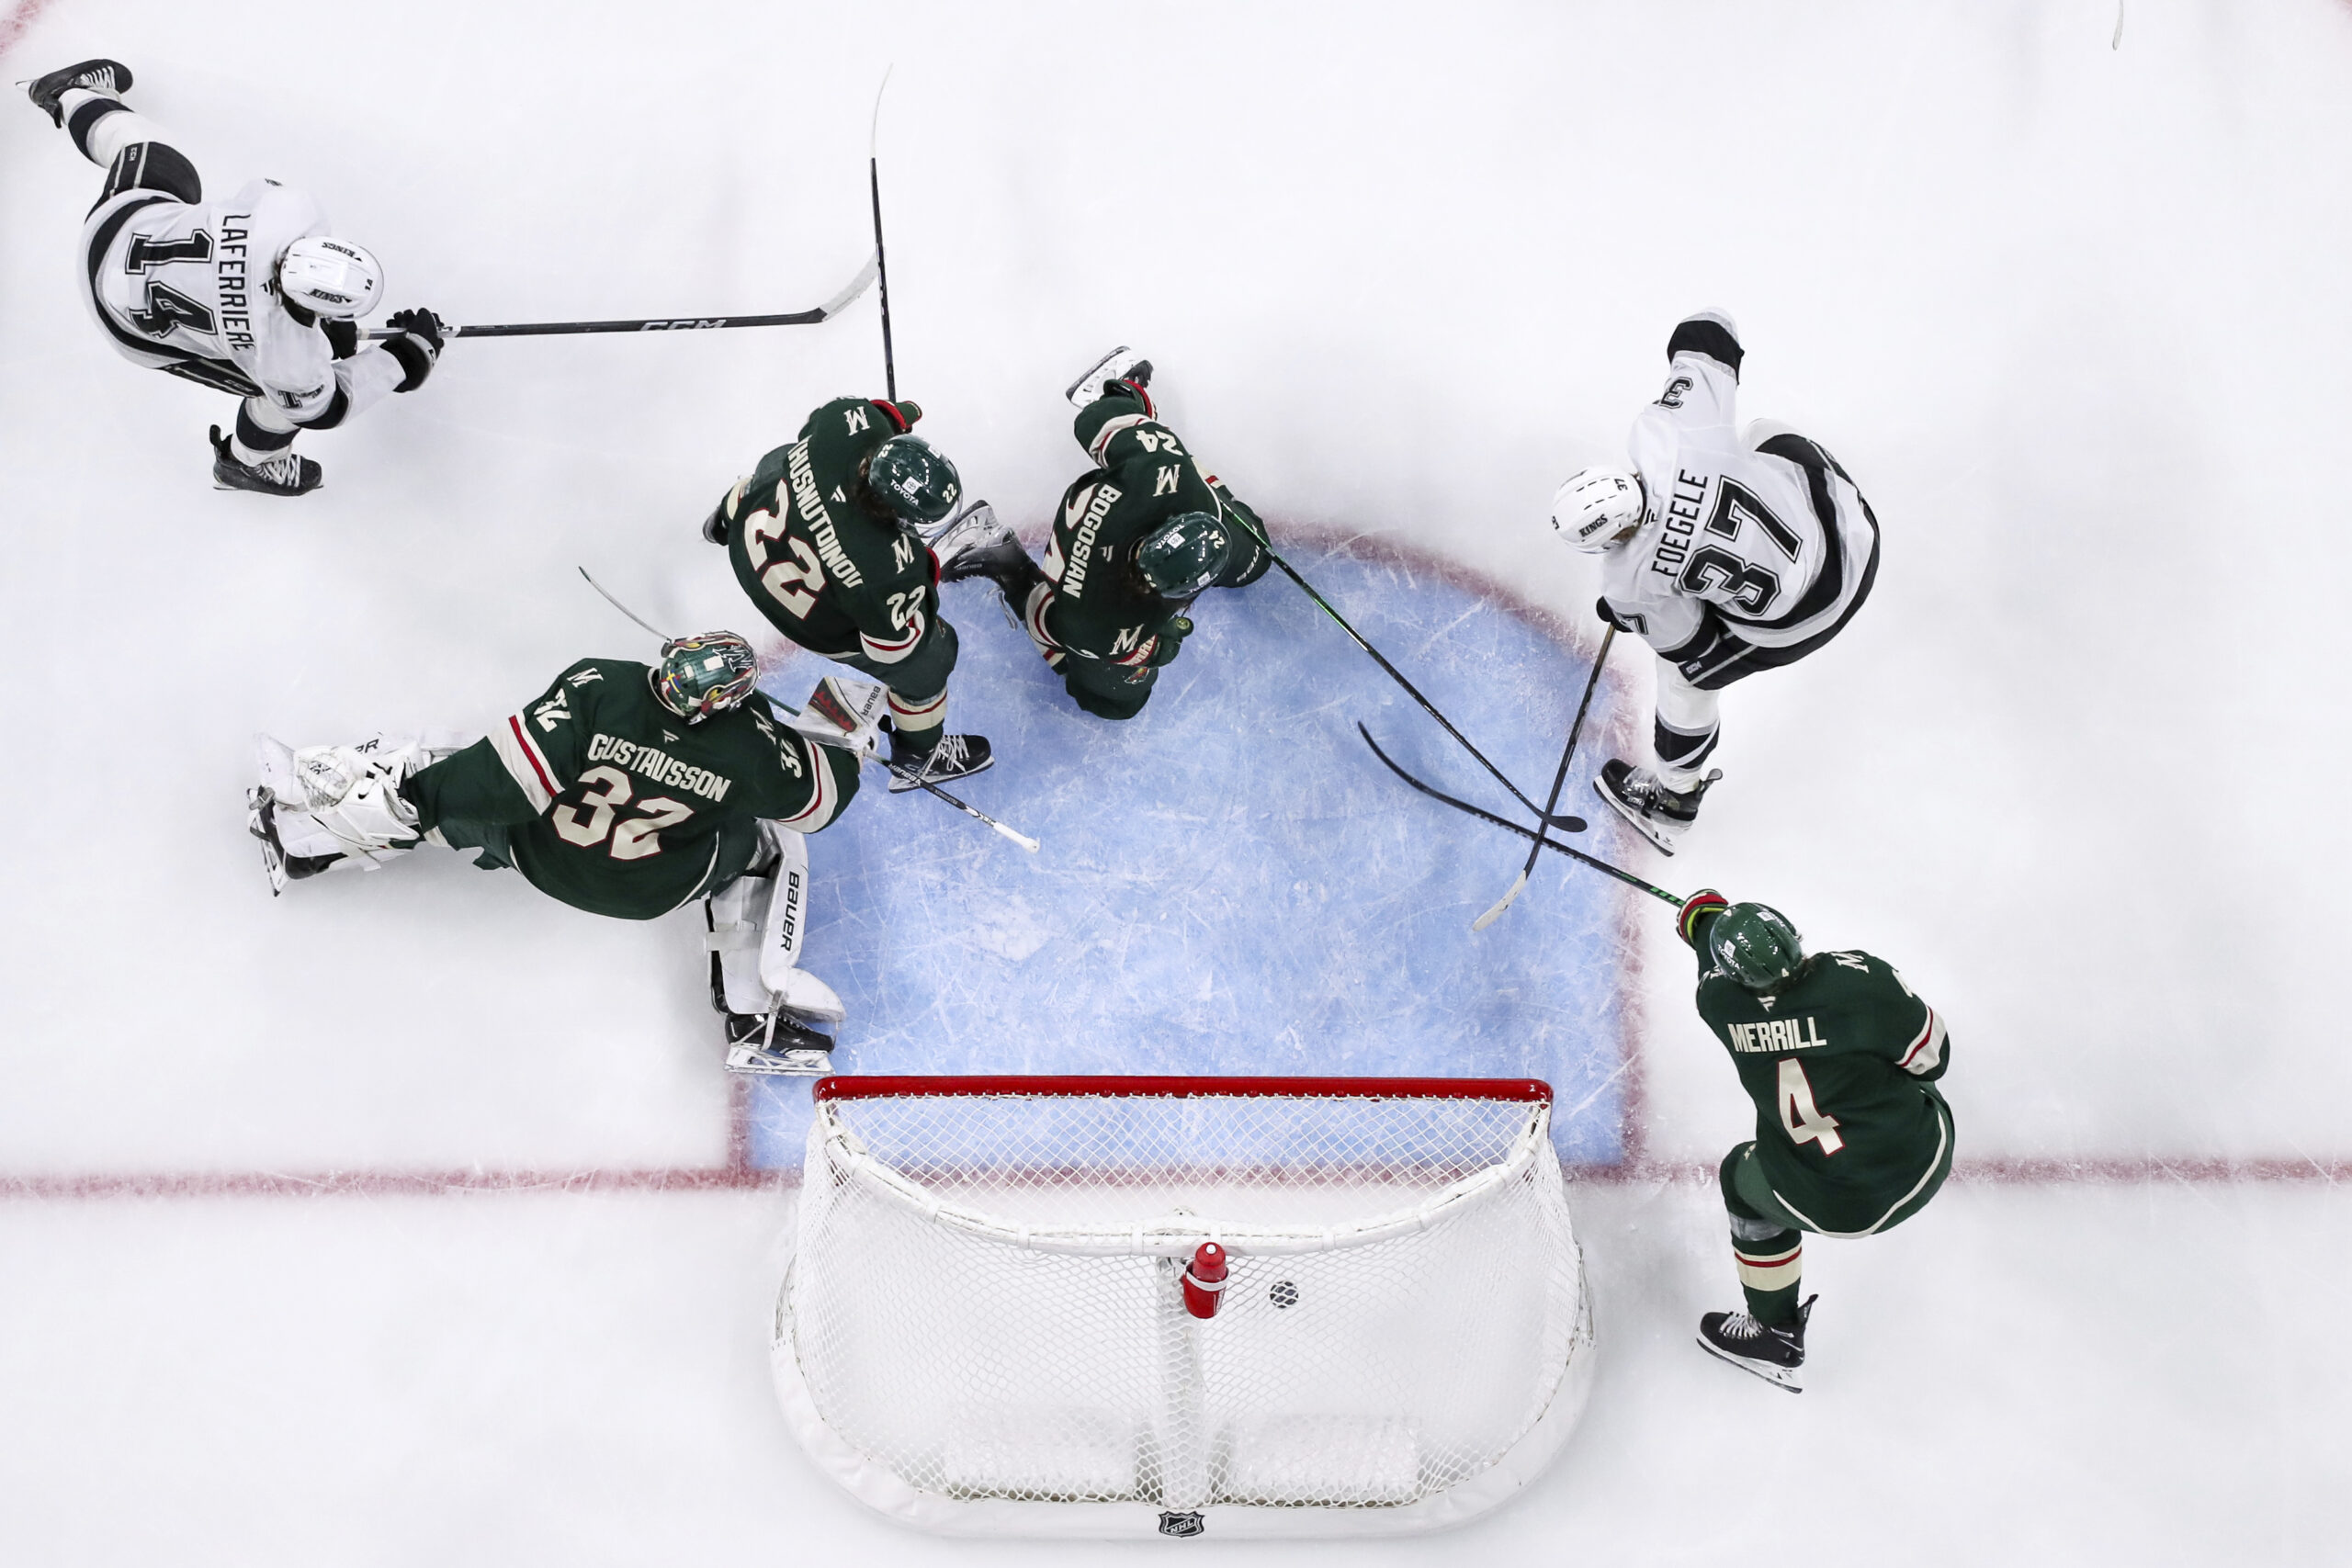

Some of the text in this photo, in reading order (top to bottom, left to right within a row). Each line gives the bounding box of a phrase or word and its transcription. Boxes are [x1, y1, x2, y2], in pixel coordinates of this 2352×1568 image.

[322, 242, 356, 258] KINGS
[125, 228, 219, 339] 14
[220, 214, 256, 352] LAFERRIERE
[640, 319, 727, 332] CCM
[1136, 429, 1184, 457] 24
[890, 479, 920, 506] TOYOTA
[942, 482, 957, 504] 22
[1613, 478, 1629, 491] 37
[1062, 483, 1123, 599] BOGOSIAN
[1155, 524, 1185, 550] TOYOTA
[1578, 513, 1609, 537] KINGS
[1651, 468, 1709, 579] FOEGELE
[1672, 474, 1804, 617] 37
[743, 477, 828, 621] 22
[886, 585, 926, 632] 22
[533, 687, 572, 733] 32
[587, 733, 732, 803] GUSTAVSSON
[551, 764, 696, 862] 32
[780, 871, 800, 952] BAUER
[1727, 1016, 1827, 1053] MERRILL
[1775, 1056, 1846, 1157] 4
[1170, 1520, 1194, 1534] NHL
